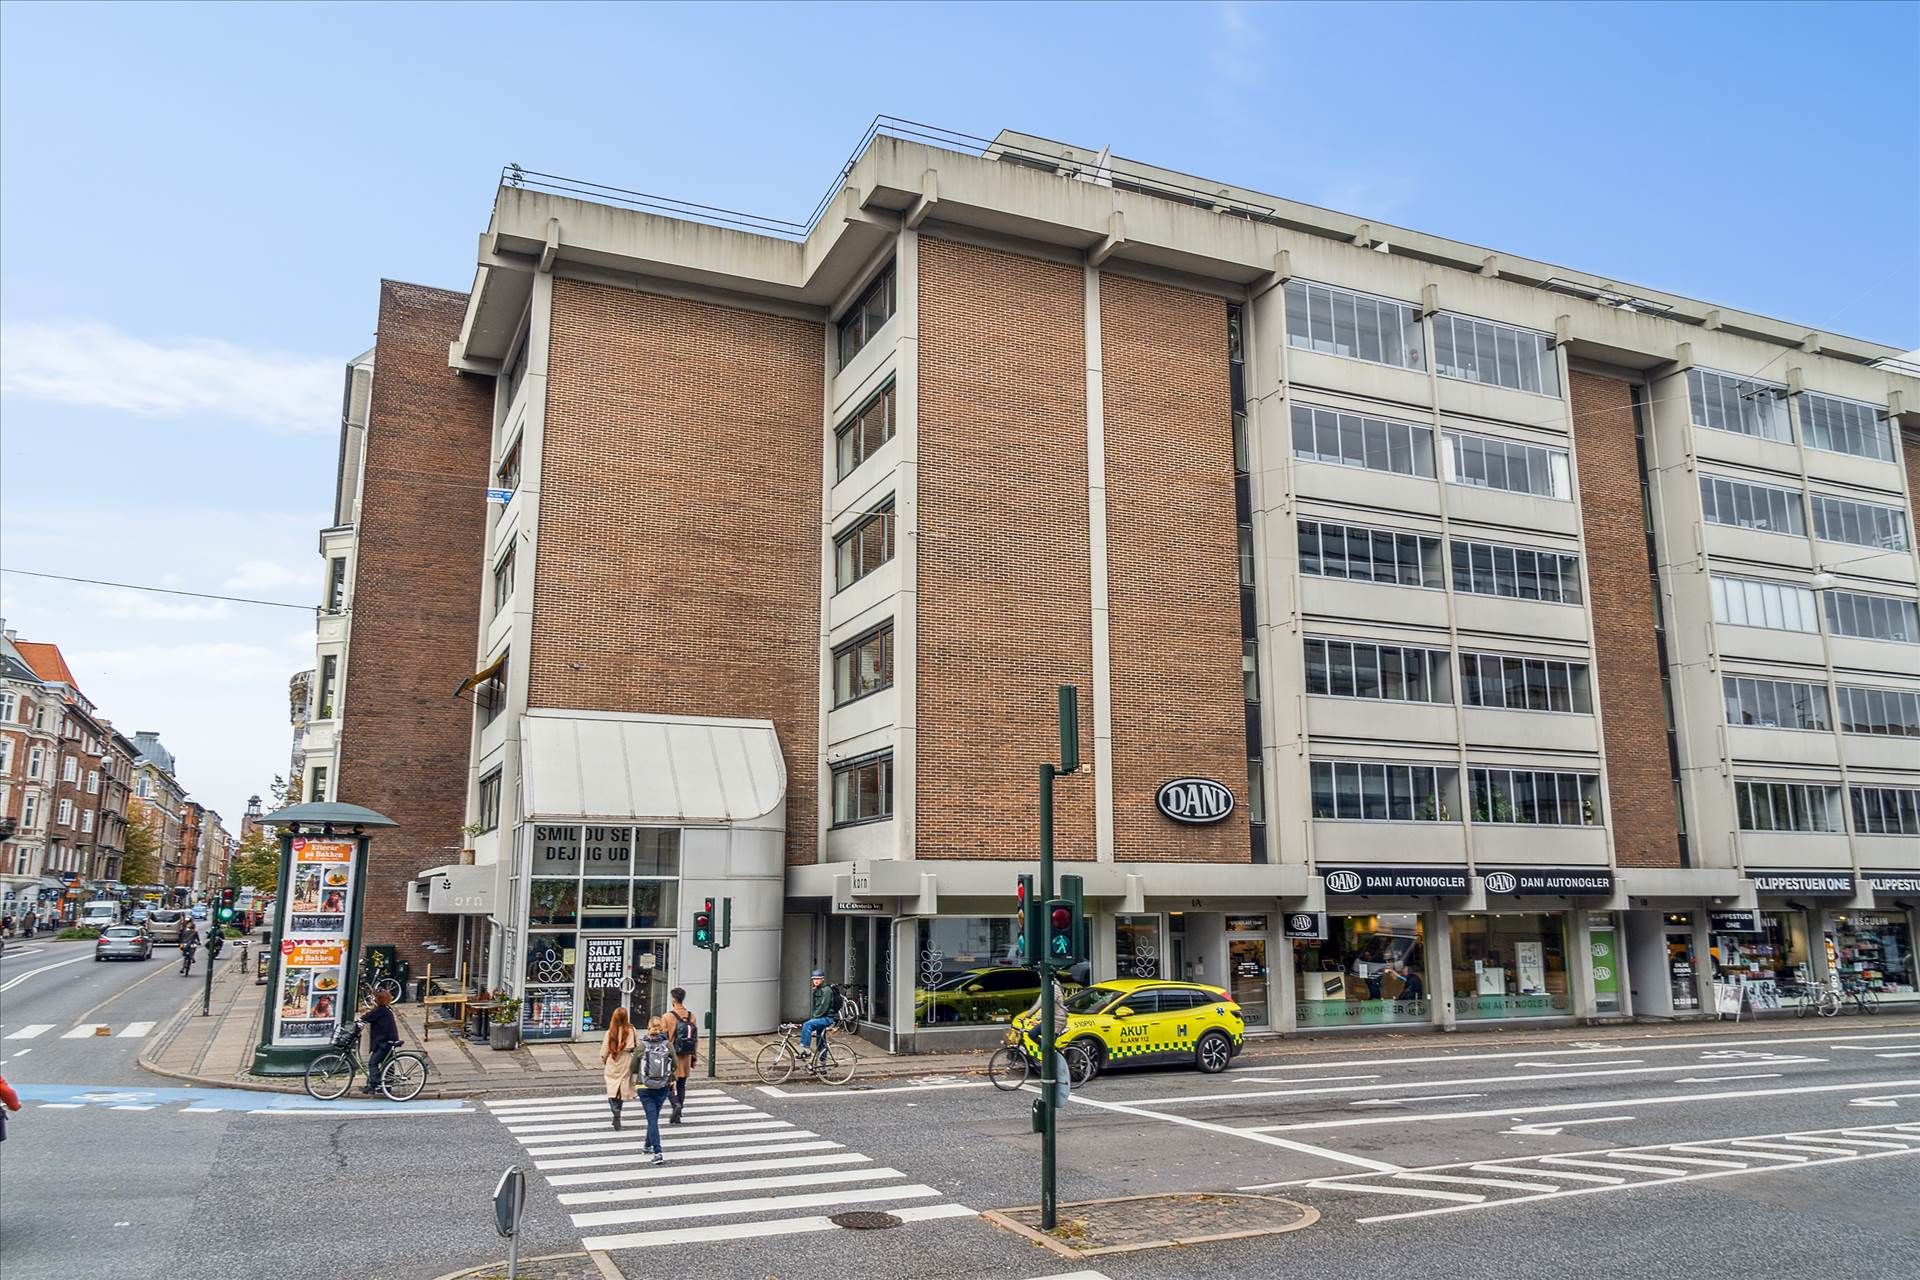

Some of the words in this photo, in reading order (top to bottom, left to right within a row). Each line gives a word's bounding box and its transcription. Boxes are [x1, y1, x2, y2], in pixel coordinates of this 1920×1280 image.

[1167, 784, 1227, 817] DANI
[537, 827, 577, 841] SMIL
[585, 828, 604, 842] DU
[608, 847, 629, 861] UD
[1330, 873, 1358, 890] DANI
[1366, 876, 1392, 887] DANI
[1395, 876, 1466, 887] AUTONØGLER
[1488, 874, 1513, 890] DANI
[1521, 877, 1544, 887] DANI
[1547, 877, 1610, 888] AUTONØGLER
[1755, 877, 1827, 890] KLIPPESTUEN
[1829, 878, 1851, 890] ONE
[588, 946, 623, 956] SALAT
[587, 963, 622, 972] KAFFE
[587, 978, 621, 988] TAPAS
[1120, 1025, 1149, 1037] AKUT
